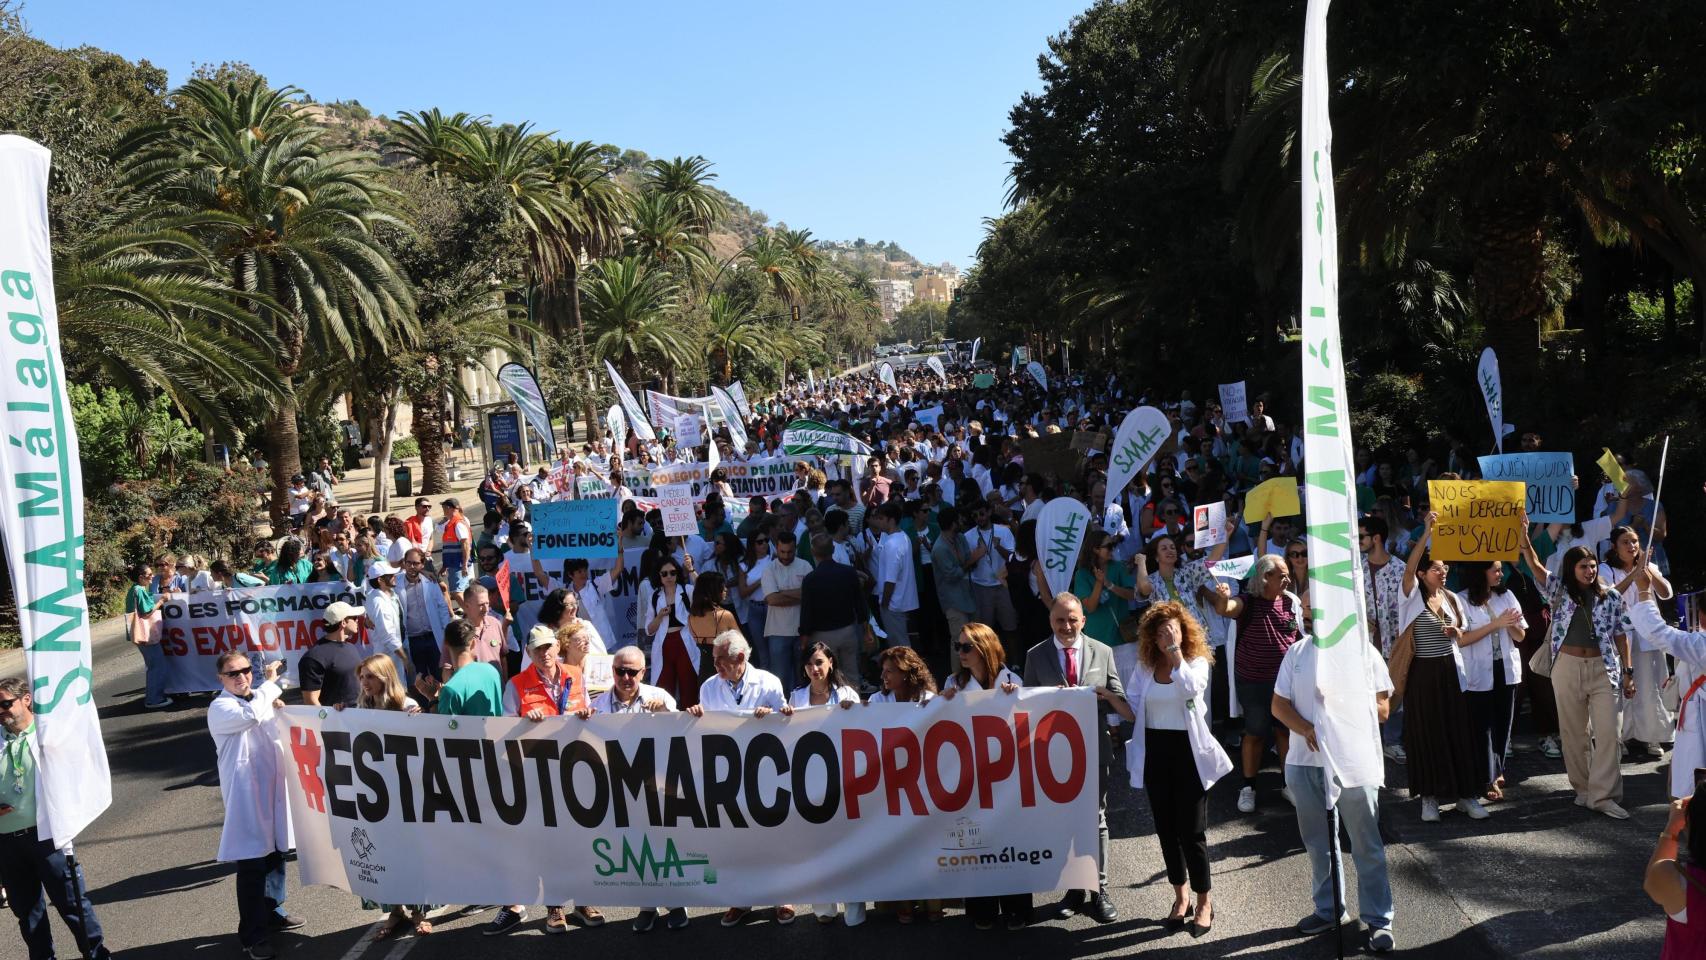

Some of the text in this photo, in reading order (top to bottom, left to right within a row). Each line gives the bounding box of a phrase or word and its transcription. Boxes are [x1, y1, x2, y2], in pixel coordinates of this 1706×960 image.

[1114, 428, 1159, 473] SMA
[652, 470, 701, 485] COLEGIO
[751, 465, 765, 476] DE
[1535, 459, 1572, 480] CUIDA
[1434, 485, 1476, 500] NO ES
[1526, 485, 1574, 516] SALUD
[1442, 505, 1459, 518] MI
[537, 532, 615, 550] FONENDOS
[1045, 519, 1080, 573] SMA
[1438, 526, 1455, 537] ES
[1459, 523, 1519, 555] SALUD
[188, 602, 219, 619] ES
[290, 709, 1087, 829] #ESTATUTOMARCOPROPIO
[592, 832, 698, 882] SMA
[937, 846, 1053, 865] commálaga
[350, 859, 387, 873] ASOCIACIÓN
